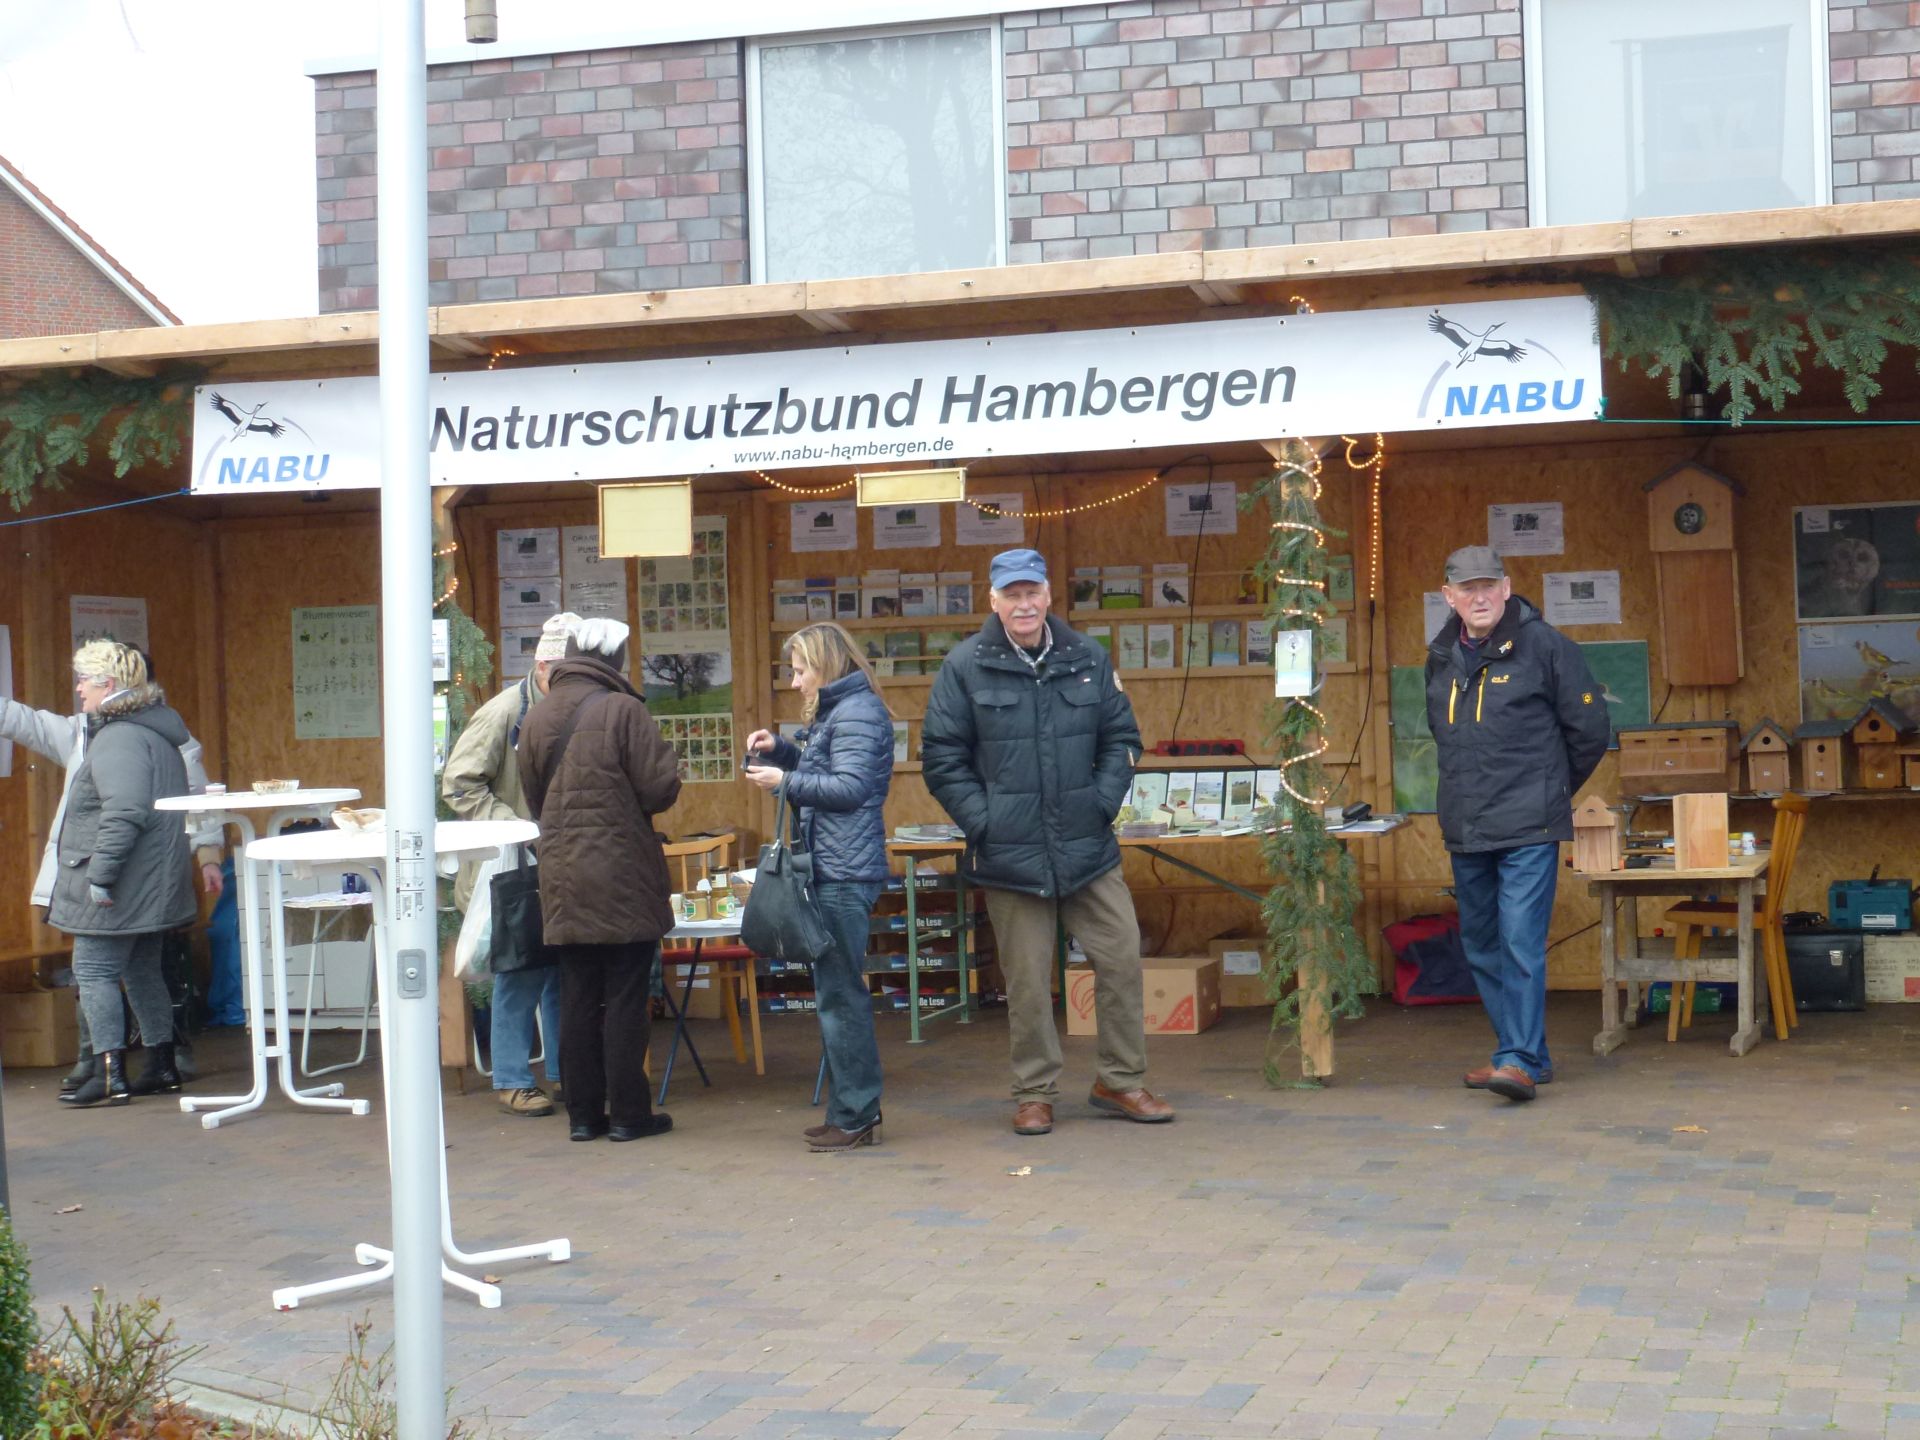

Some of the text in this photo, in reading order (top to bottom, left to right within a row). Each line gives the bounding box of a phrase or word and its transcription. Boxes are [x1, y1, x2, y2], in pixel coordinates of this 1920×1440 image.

[430, 364, 1297, 453] Naturschutzbund Hambergen
[1444, 378, 1585, 417] NABU
[733, 437, 954, 464] www.nabu-hambergen.de
[217, 454, 331, 485] NABU
[926, 917, 942, 927] Lese
[926, 957, 942, 967] Lese
[929, 997, 945, 1006] Lese
